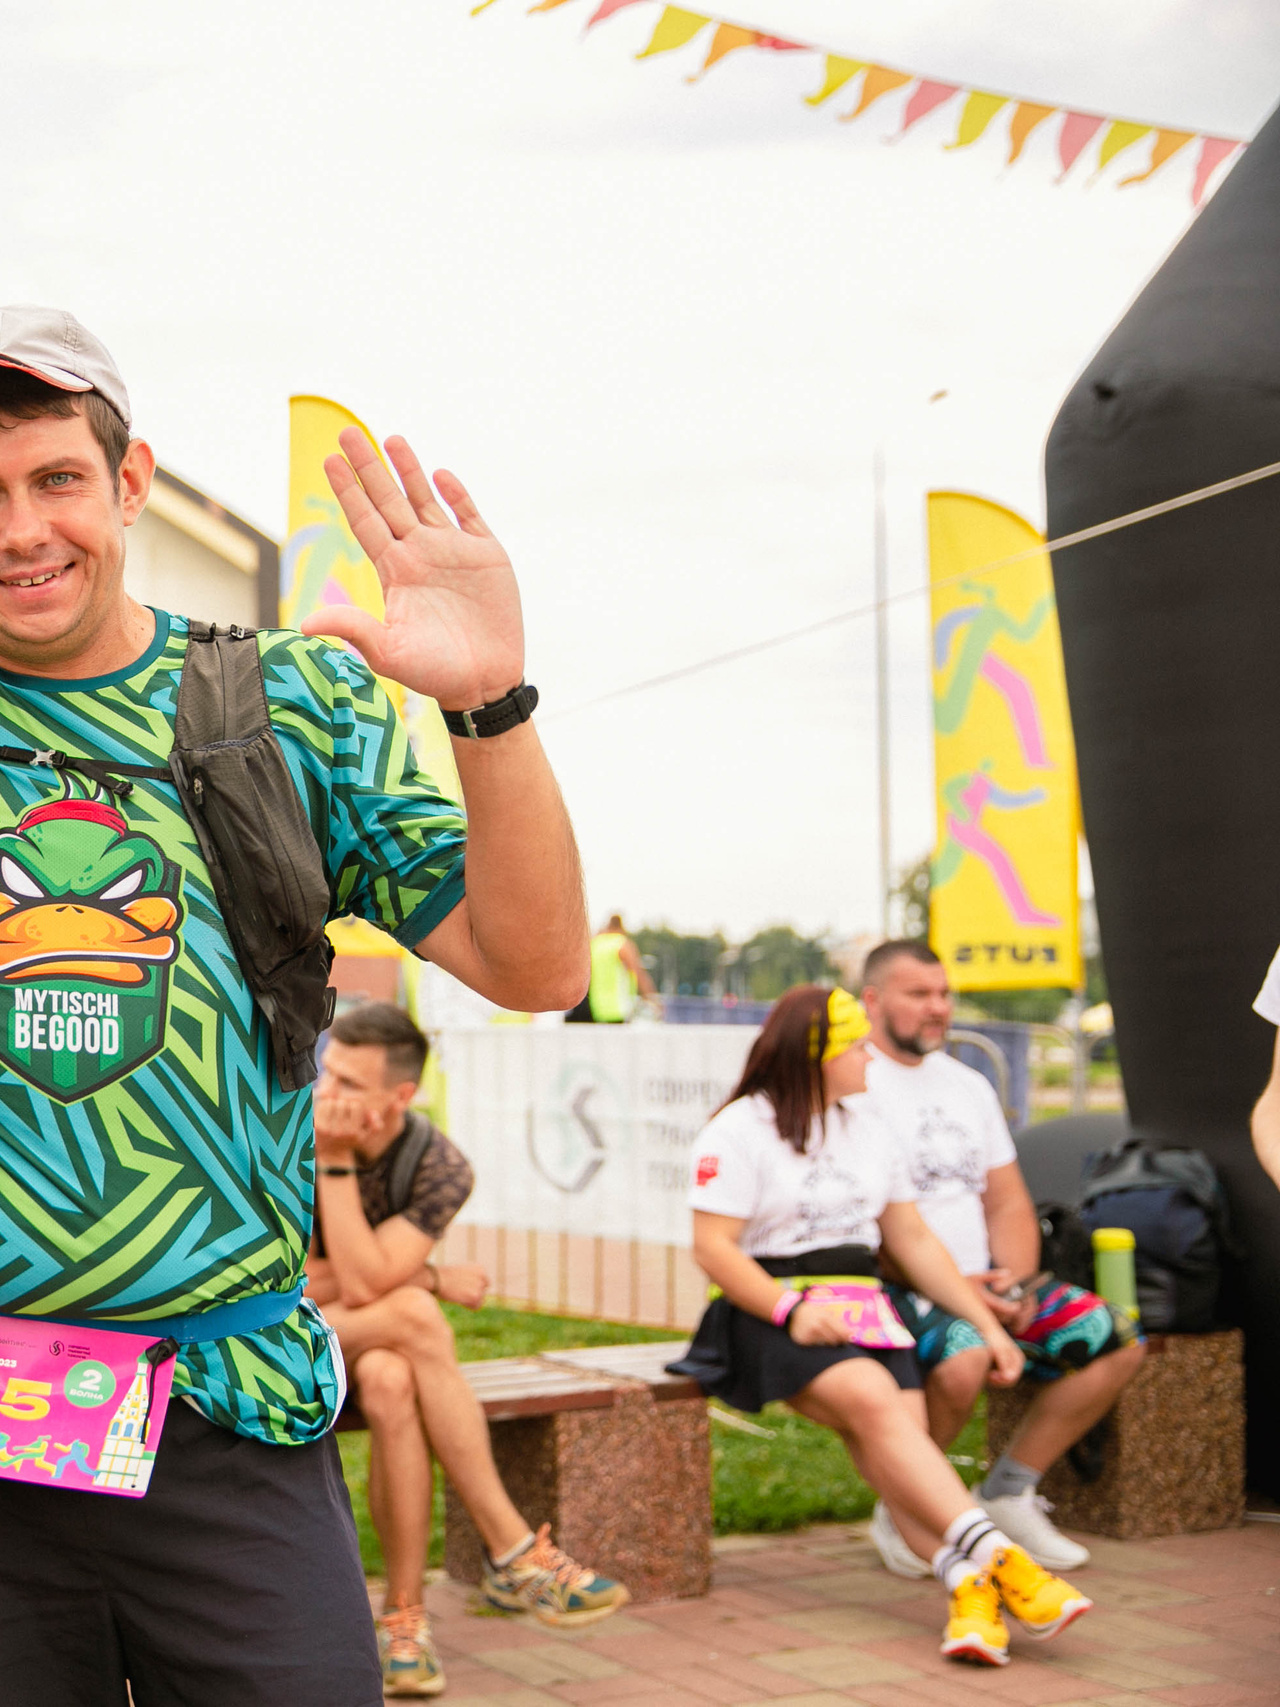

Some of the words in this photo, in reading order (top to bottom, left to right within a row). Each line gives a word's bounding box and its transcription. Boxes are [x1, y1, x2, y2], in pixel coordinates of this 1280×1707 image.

[14, 987, 119, 1017] MYTISCHI
[14, 1012, 120, 1056] BEGOOD
[78, 1368, 103, 1392] 2
[69, 1388, 104, 1401] ВОЛНА
